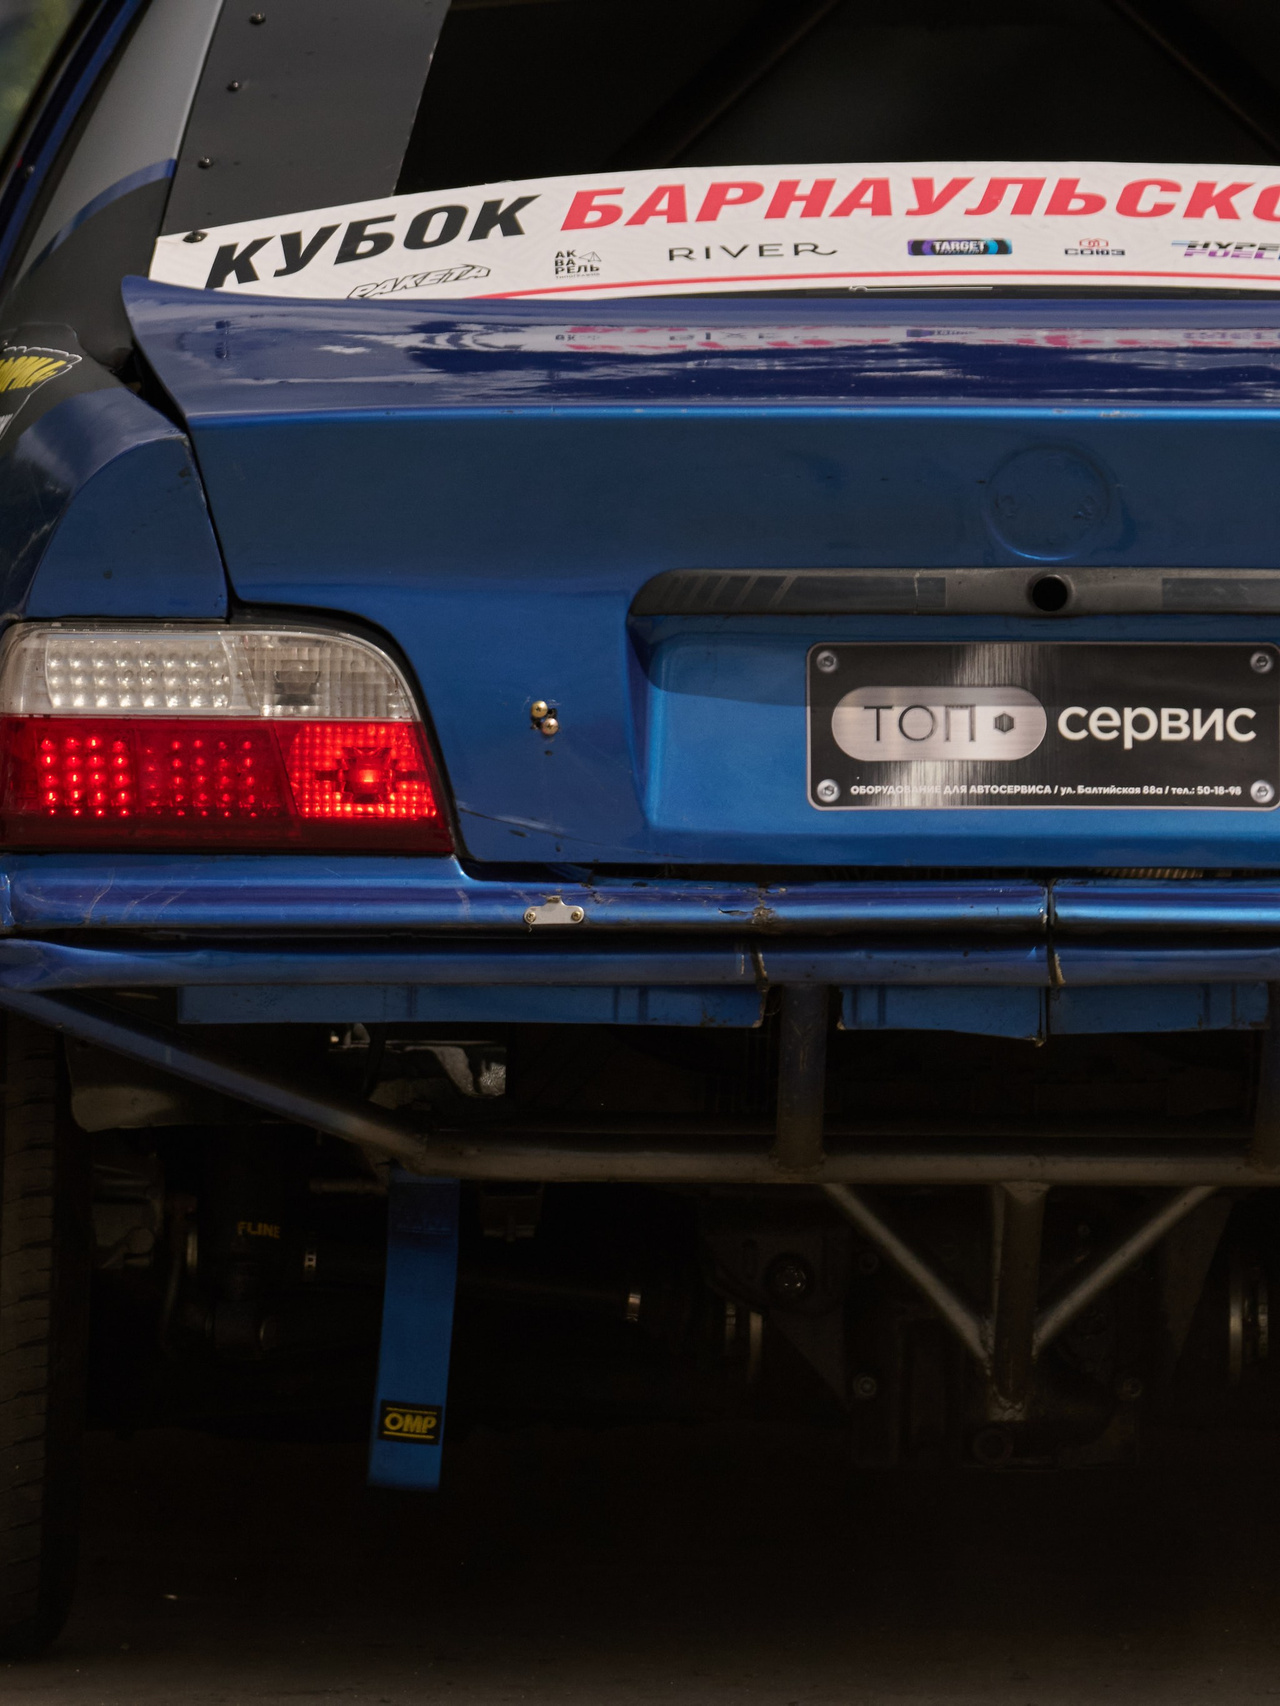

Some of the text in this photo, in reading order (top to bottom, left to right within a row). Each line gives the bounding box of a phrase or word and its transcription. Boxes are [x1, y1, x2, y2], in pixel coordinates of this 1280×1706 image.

[205, 193, 542, 290] КУБОК
[933, 240, 985, 253] TARGET
[669, 242, 838, 262] RIVER
[555, 264, 600, 275] РЕЛЬ
[864, 705, 1257, 749] ТОП сервис
[850, 785, 941, 795] ОБОРУДОВАНИЕ
[943, 785, 967, 795] ДЛЯ
[969, 785, 1052, 795] АВТОСЕРВИСА
[1060, 786, 1076, 796] ул.
[1077, 785, 1141, 795] Балтийская
[1197, 786, 1242, 796] 50-18-98
[384, 1412, 437, 1434] OMP
